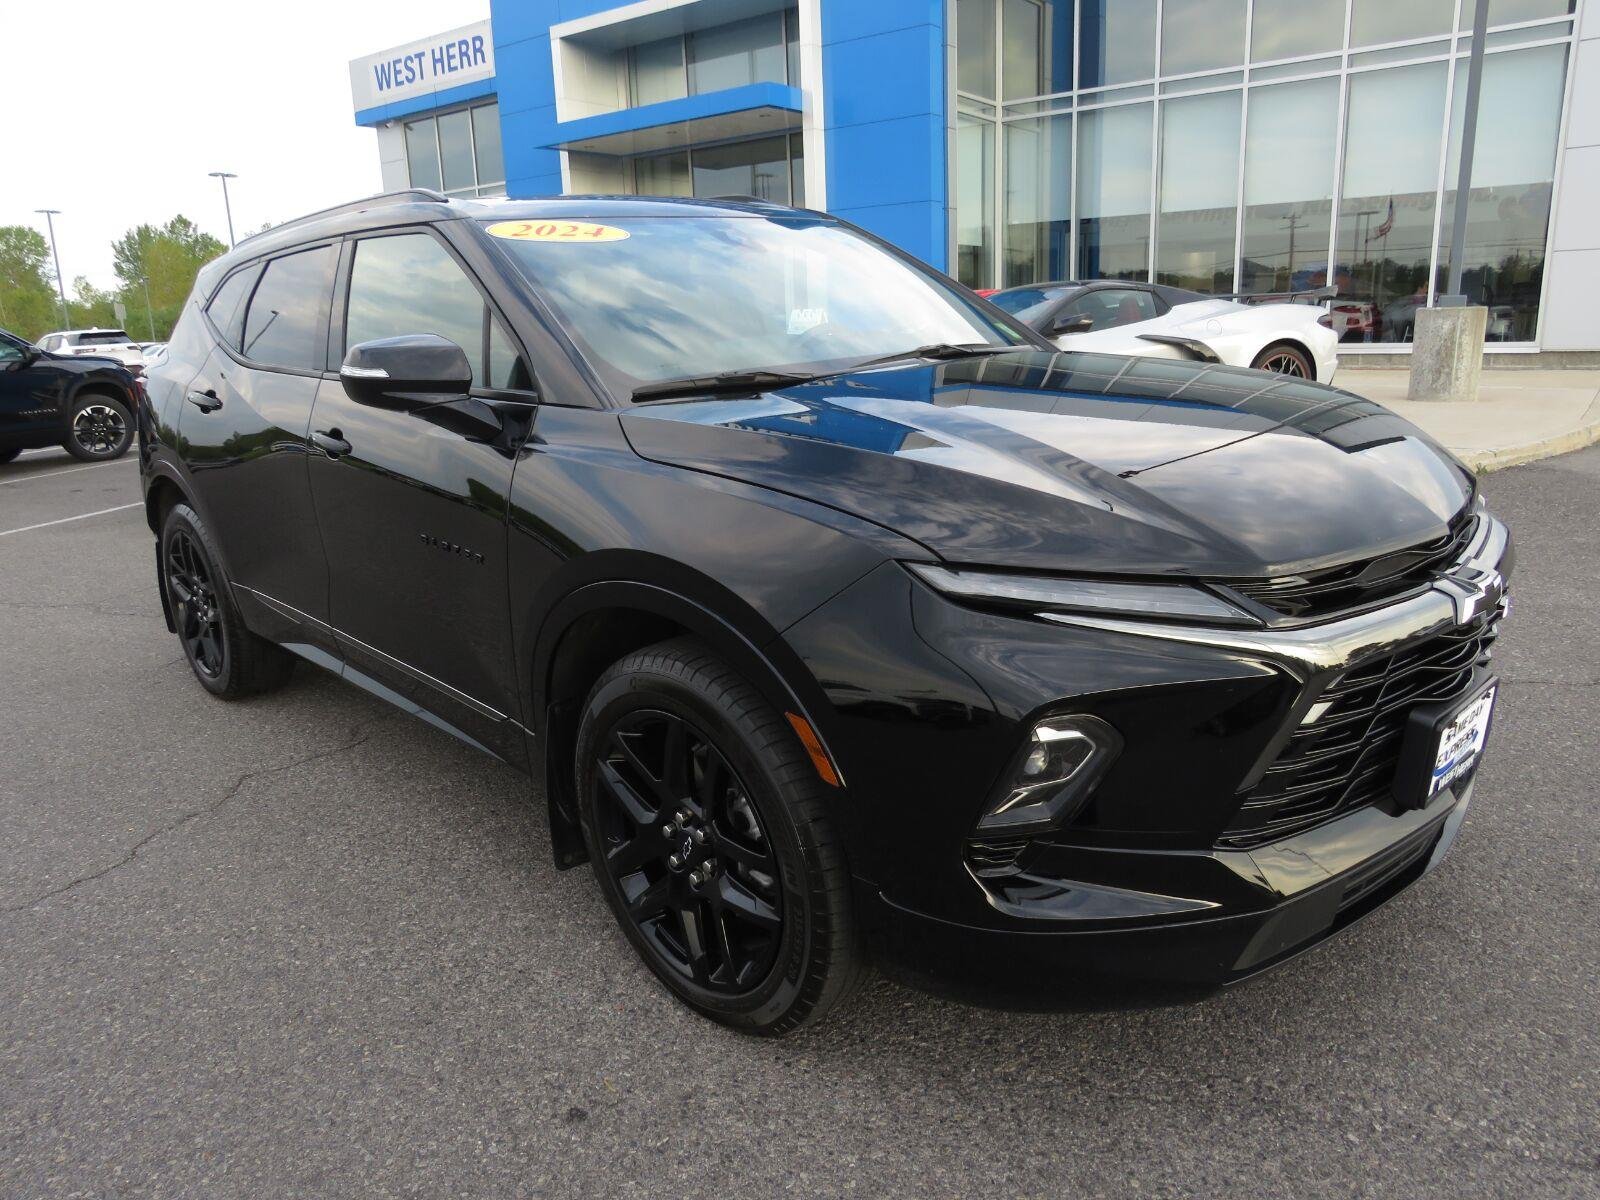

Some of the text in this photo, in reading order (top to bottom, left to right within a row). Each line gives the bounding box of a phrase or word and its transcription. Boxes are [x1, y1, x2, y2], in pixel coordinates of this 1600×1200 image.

[374, 35, 487, 92] WEST HERR
[511, 224, 604, 237] 2024
